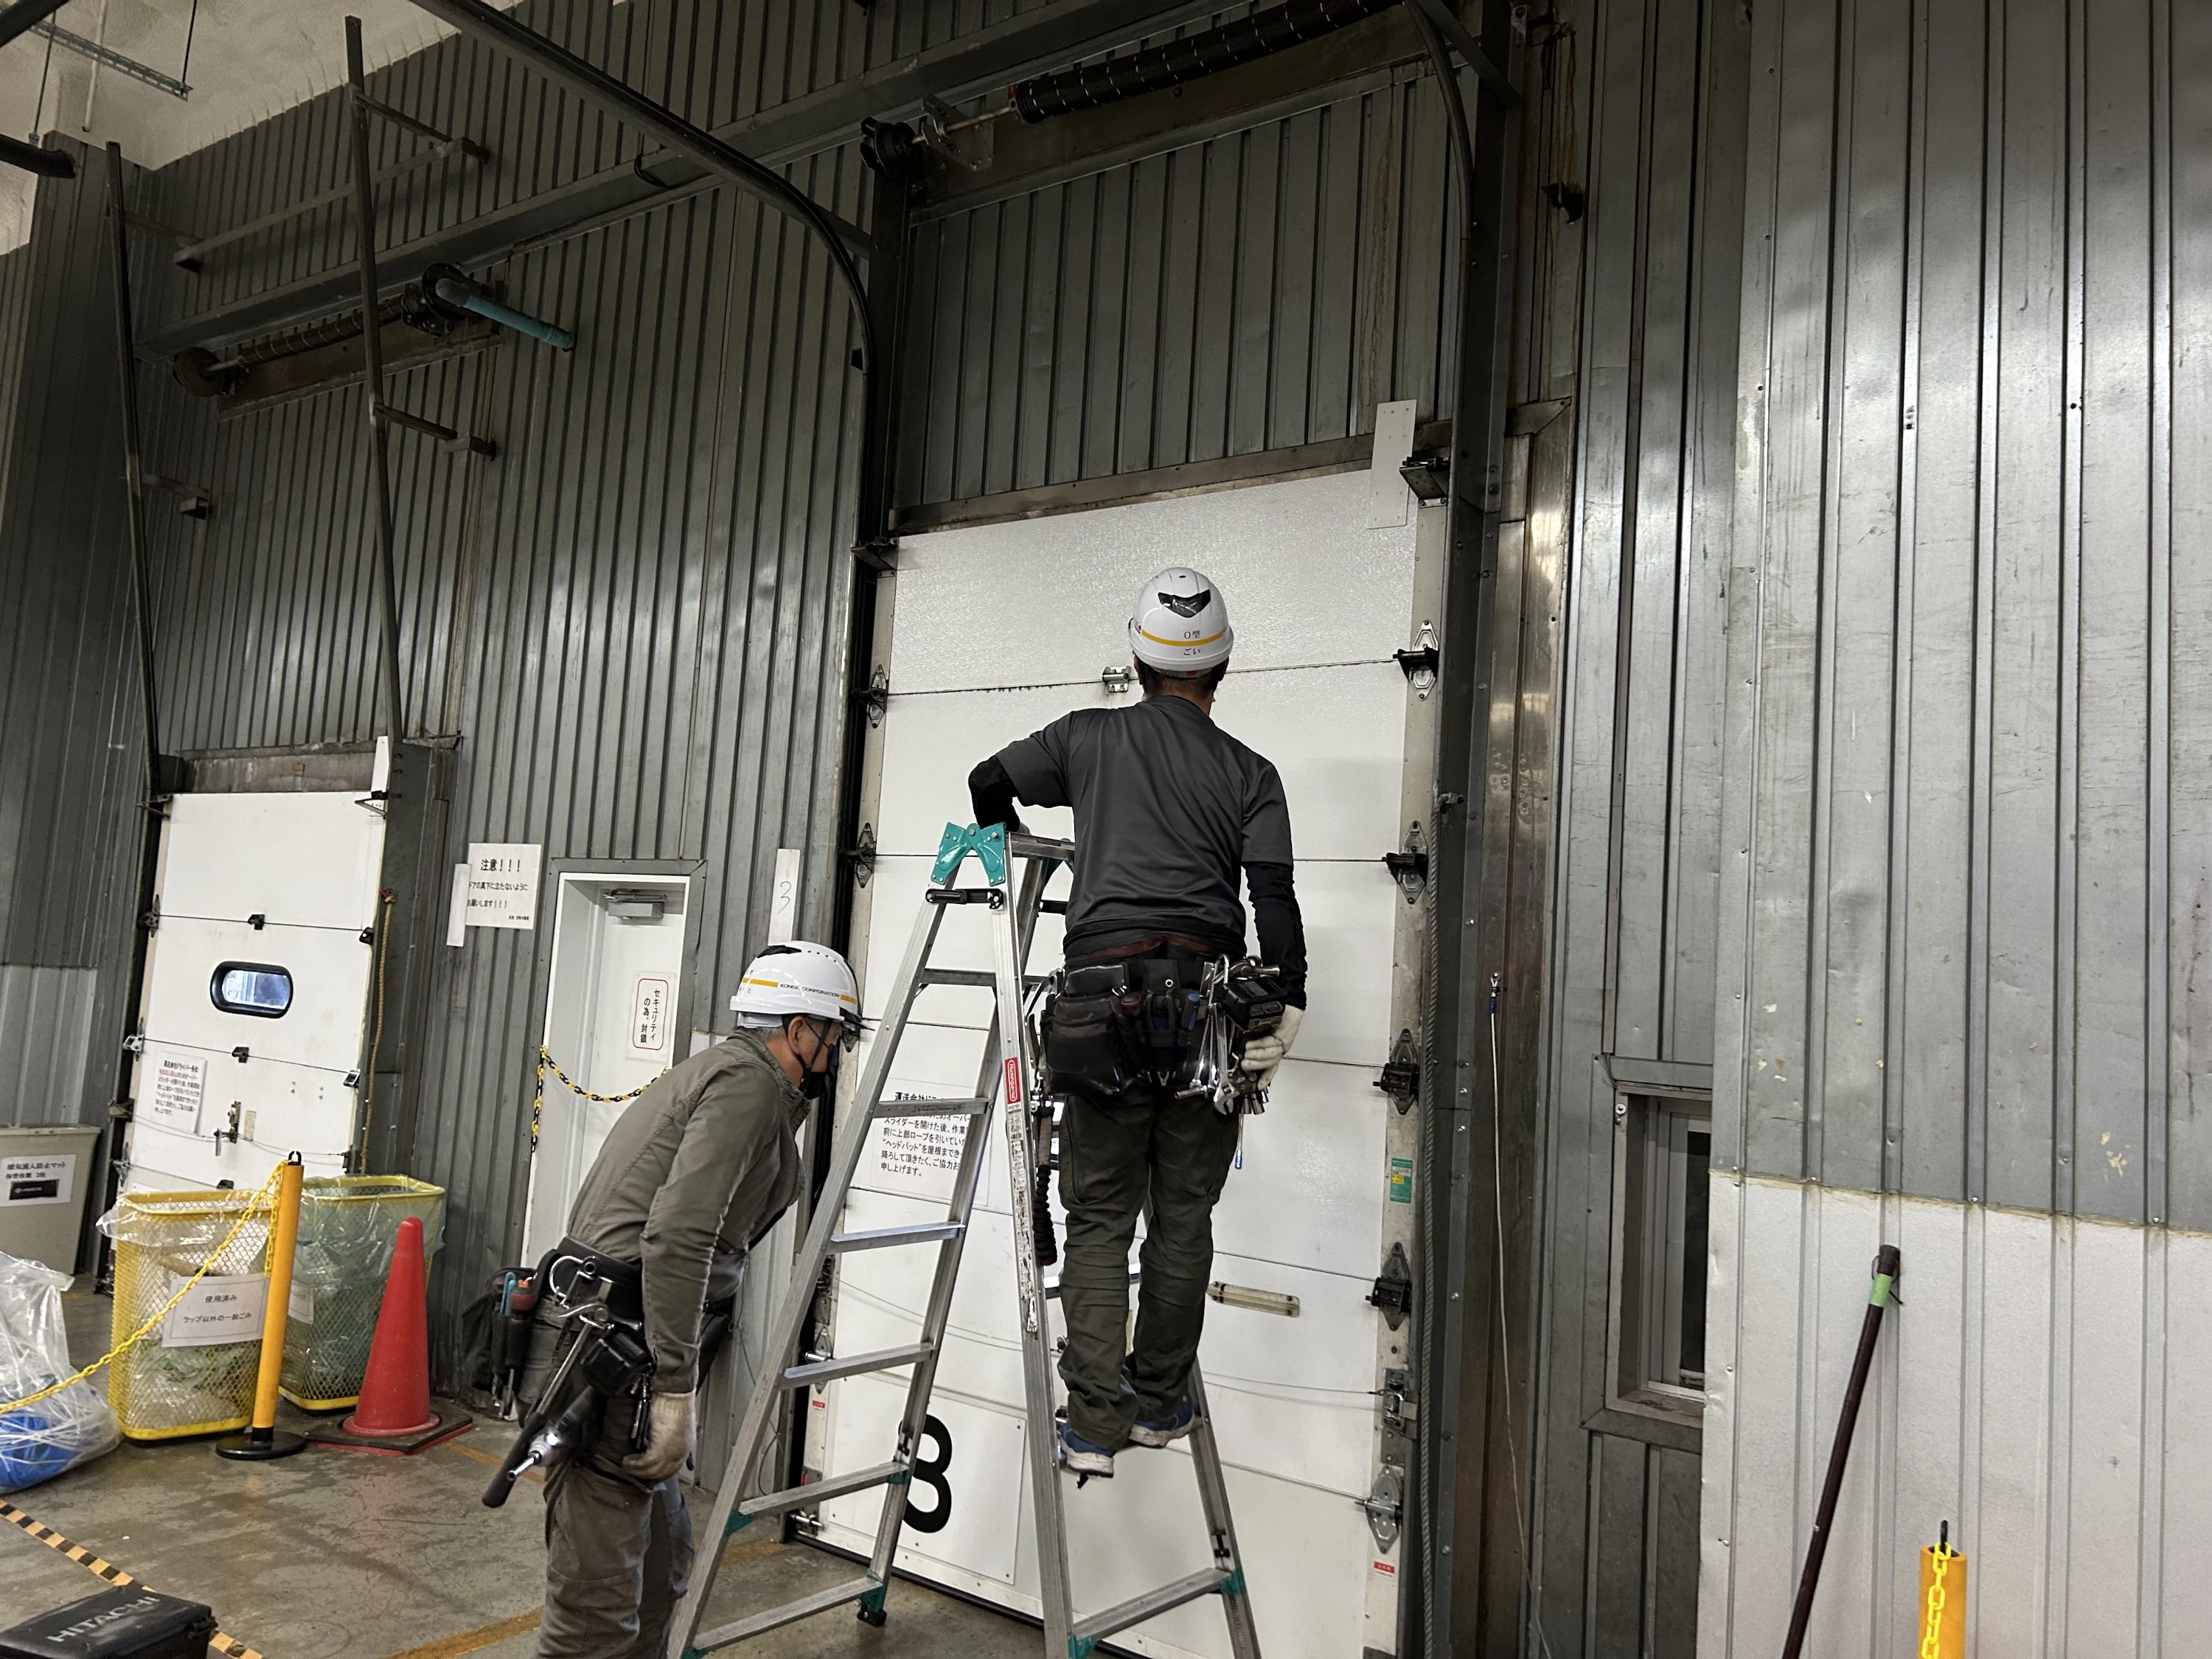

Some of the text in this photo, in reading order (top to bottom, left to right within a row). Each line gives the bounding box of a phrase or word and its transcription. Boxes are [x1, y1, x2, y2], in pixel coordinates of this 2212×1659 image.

[802, 987, 840, 998] CORPORATION
[650, 989, 661, 1041] セキュリティ
[884, 1117, 969, 1135] スライダーを開けた後、作業
[881, 1163, 922, 1178] 申し上げます。
[46, 1596, 161, 1643] HITACHI
